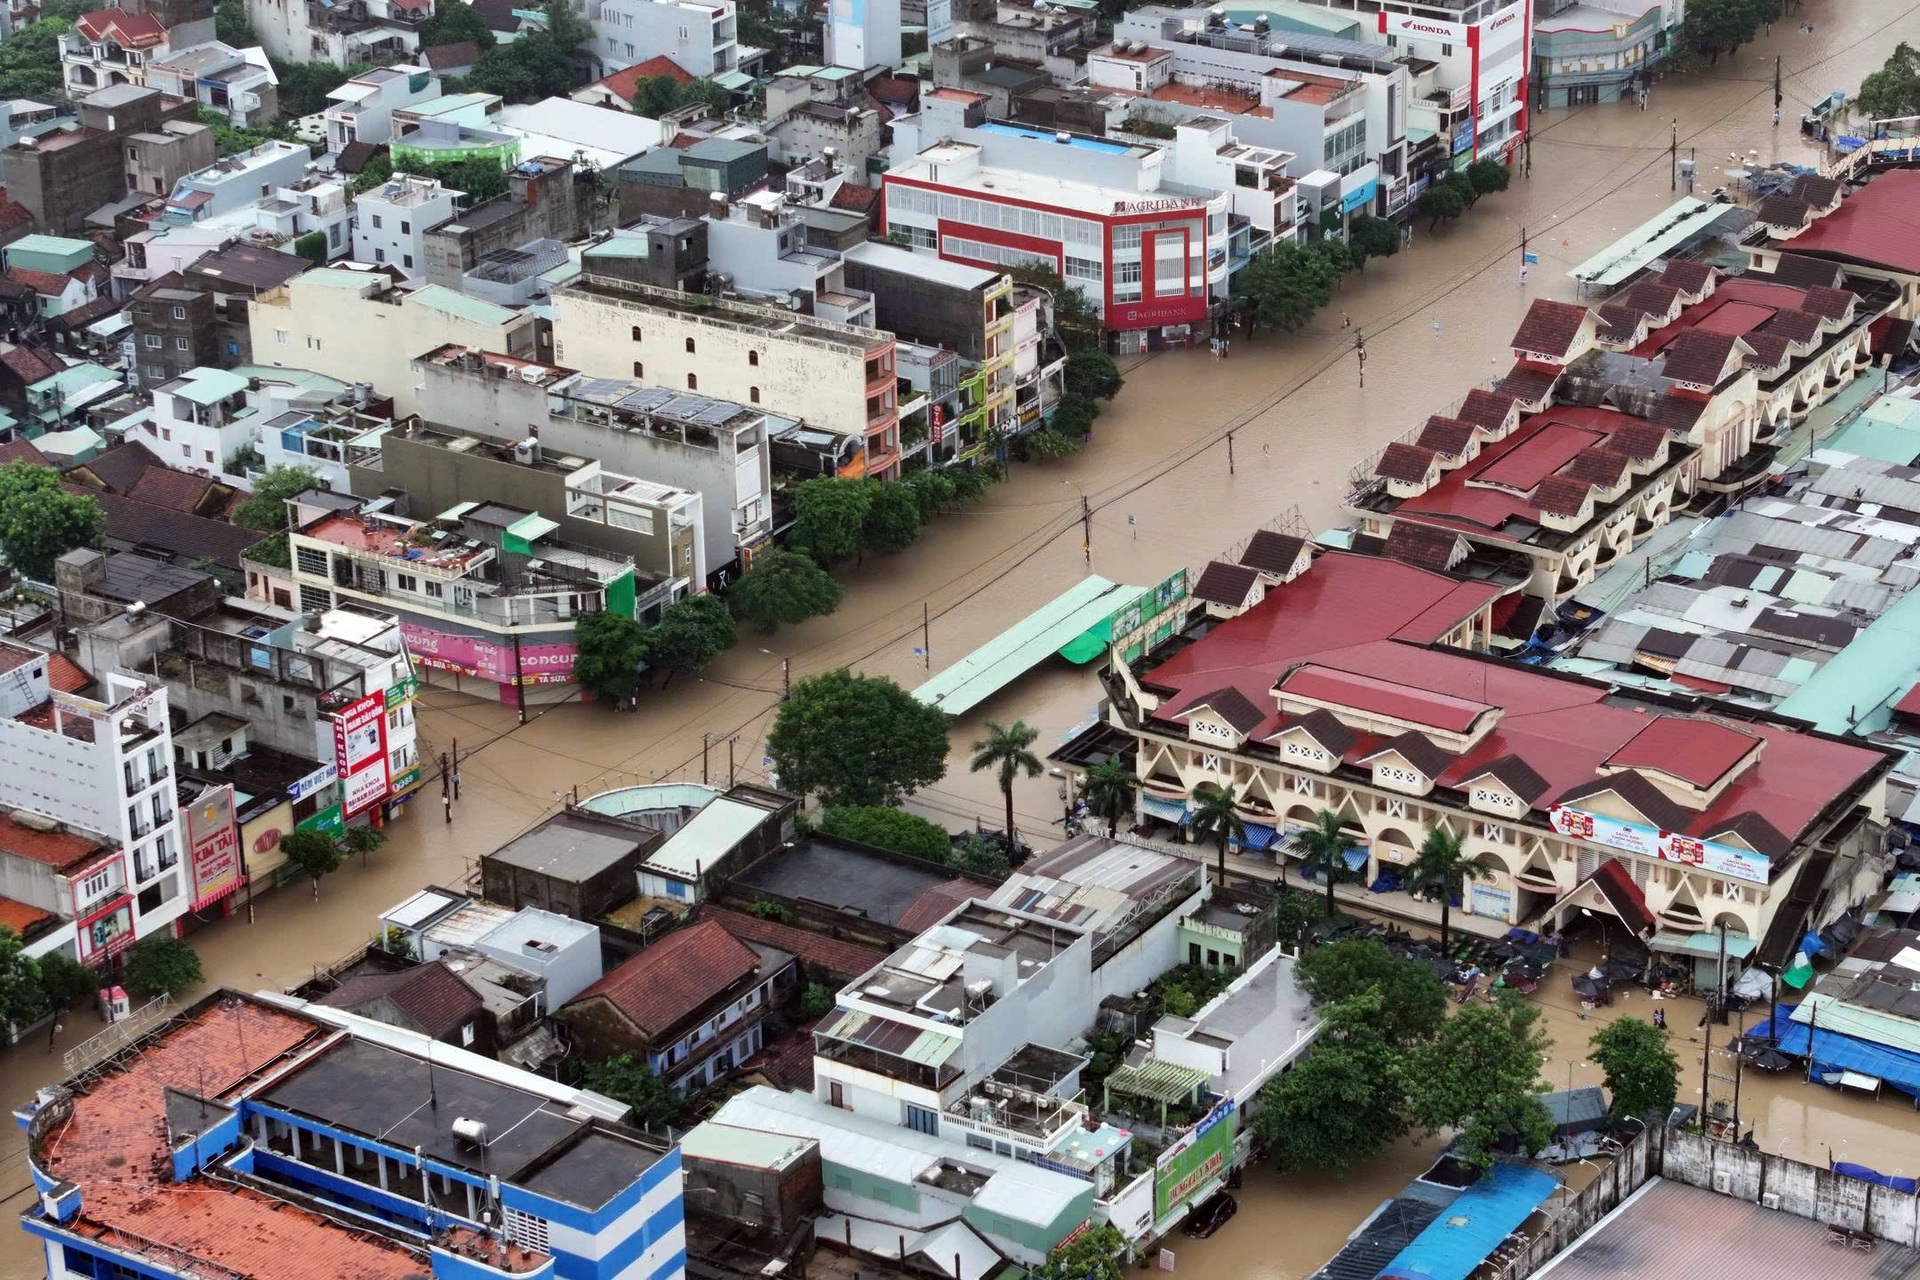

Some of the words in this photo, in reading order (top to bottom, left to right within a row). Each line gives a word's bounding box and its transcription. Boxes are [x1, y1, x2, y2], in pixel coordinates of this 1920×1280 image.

[1495, 13, 1515, 28] HONDA
[1413, 24, 1451, 36] HONDA
[1128, 197, 1201, 212] AGRIBANK
[1138, 308, 1187, 319] AGRIBANK
